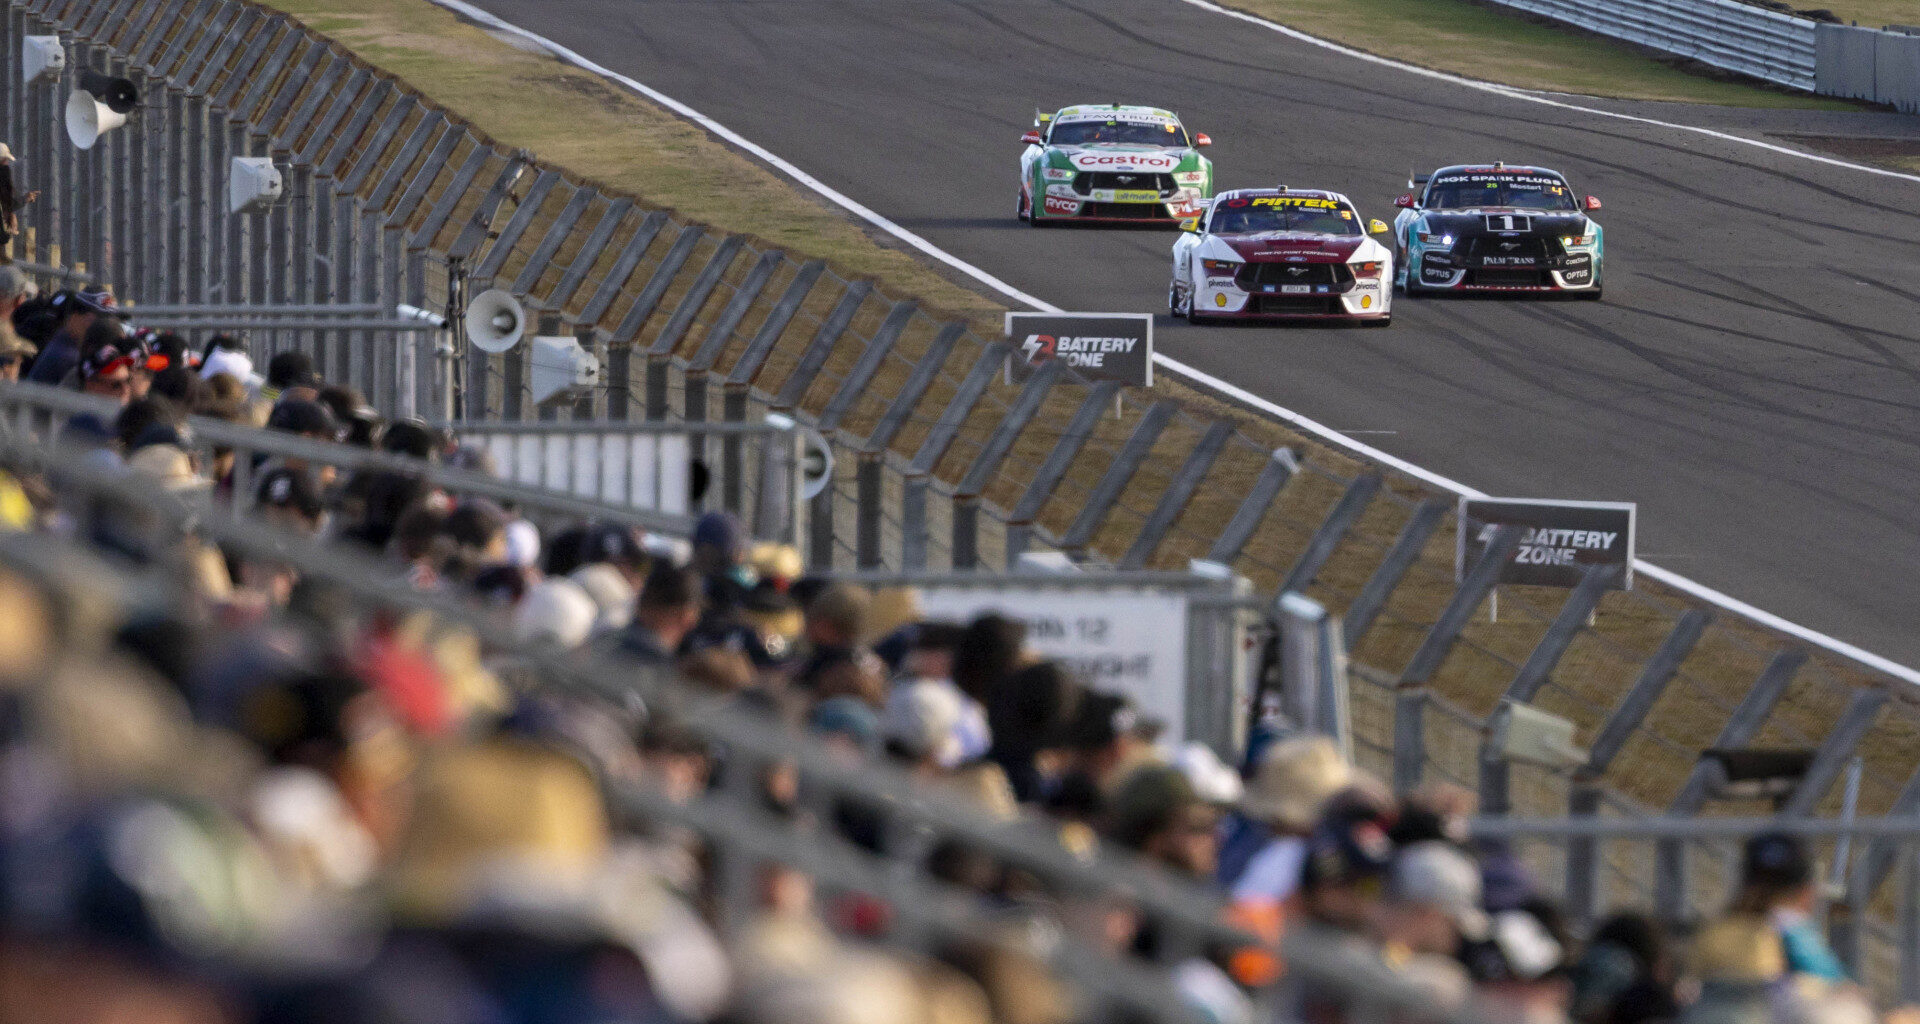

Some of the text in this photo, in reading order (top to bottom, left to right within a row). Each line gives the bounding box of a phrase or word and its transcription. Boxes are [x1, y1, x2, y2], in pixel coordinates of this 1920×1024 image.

[1079, 155, 1171, 167] Castrol
[1438, 175, 1469, 184] NGK
[1517, 176, 1562, 186] PLUGS
[1046, 197, 1079, 212] RYCO
[1251, 198, 1338, 209] PIRTEK
[1499, 215, 1513, 230] 1
[1483, 256, 1506, 265] PALM
[1425, 268, 1450, 279] OPTUS
[1566, 270, 1588, 280] OPTUS
[1057, 336, 1137, 353] BATTERY
